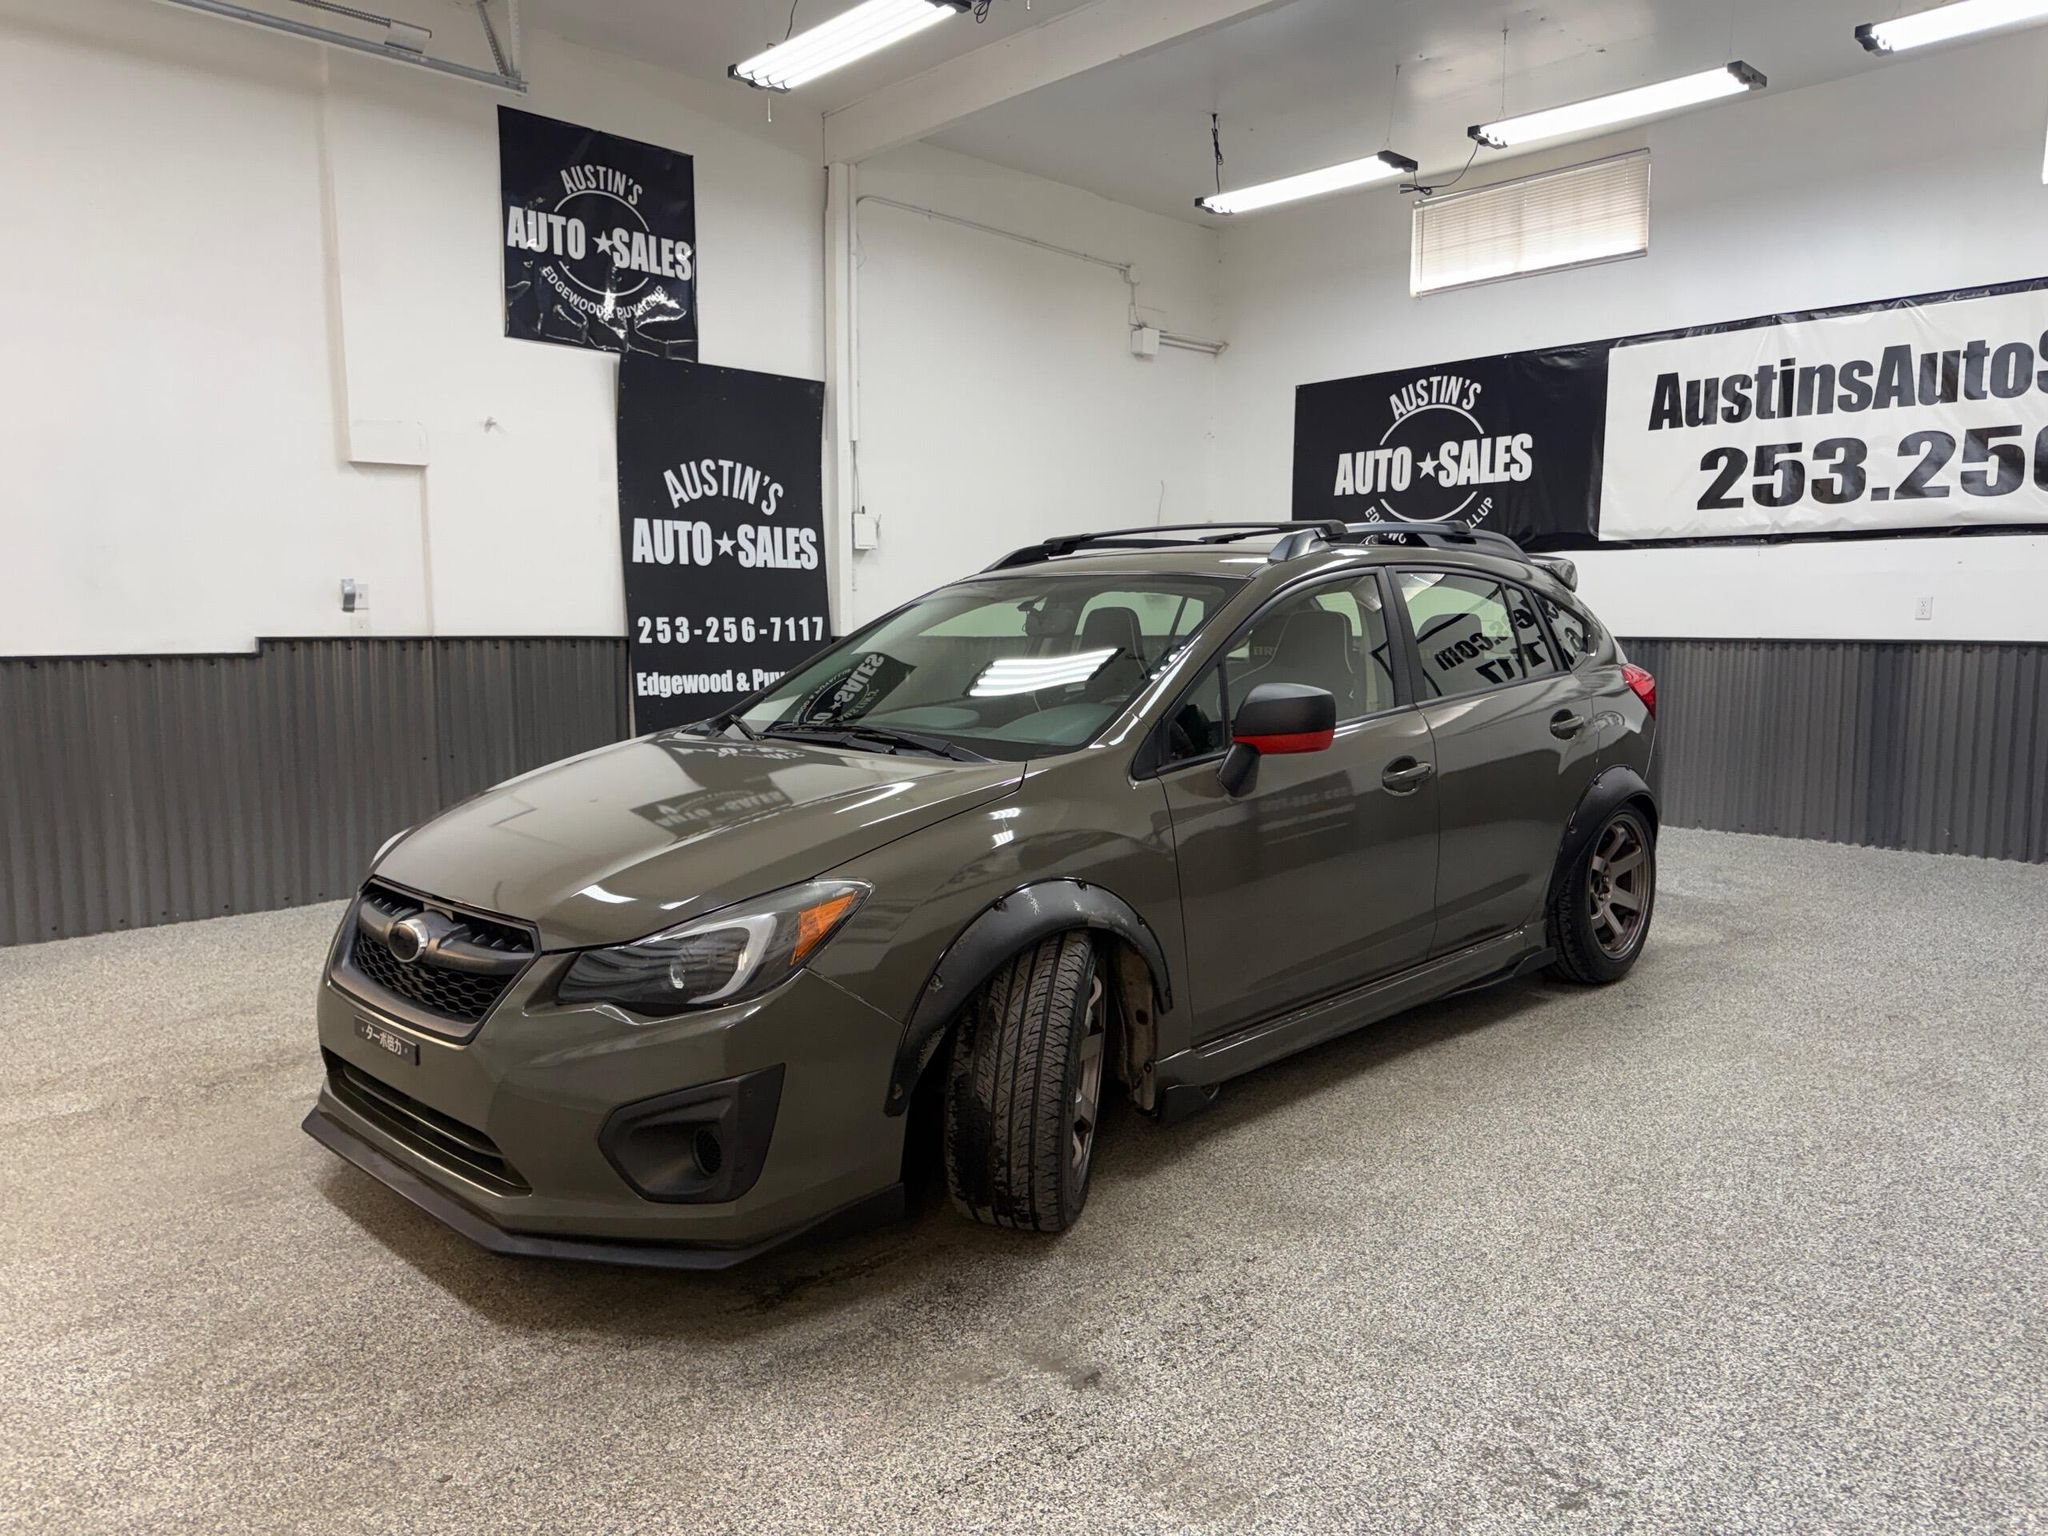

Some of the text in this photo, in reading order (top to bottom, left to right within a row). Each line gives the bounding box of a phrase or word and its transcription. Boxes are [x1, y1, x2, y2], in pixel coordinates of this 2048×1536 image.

[560, 164, 643, 206] AUSTIN'S
[507, 206, 692, 281] AUTO SALES
[542, 265, 606, 317] EDGEWOOD
[1389, 375, 1482, 421] AUSTIN'S
[1648, 328, 2048, 431] AustinsAuto
[663, 458, 784, 516] AUSTIN'S
[1334, 433, 1533, 496] AUTO SALES
[1697, 424, 2048, 511] 253.25
[1465, 497, 1493, 529] LLUP
[632, 517, 818, 570] AUTO SALES
[637, 616, 824, 644] 253-256-7117
[636, 669, 734, 698] Edgewood
[736, 672, 750, 692] &
